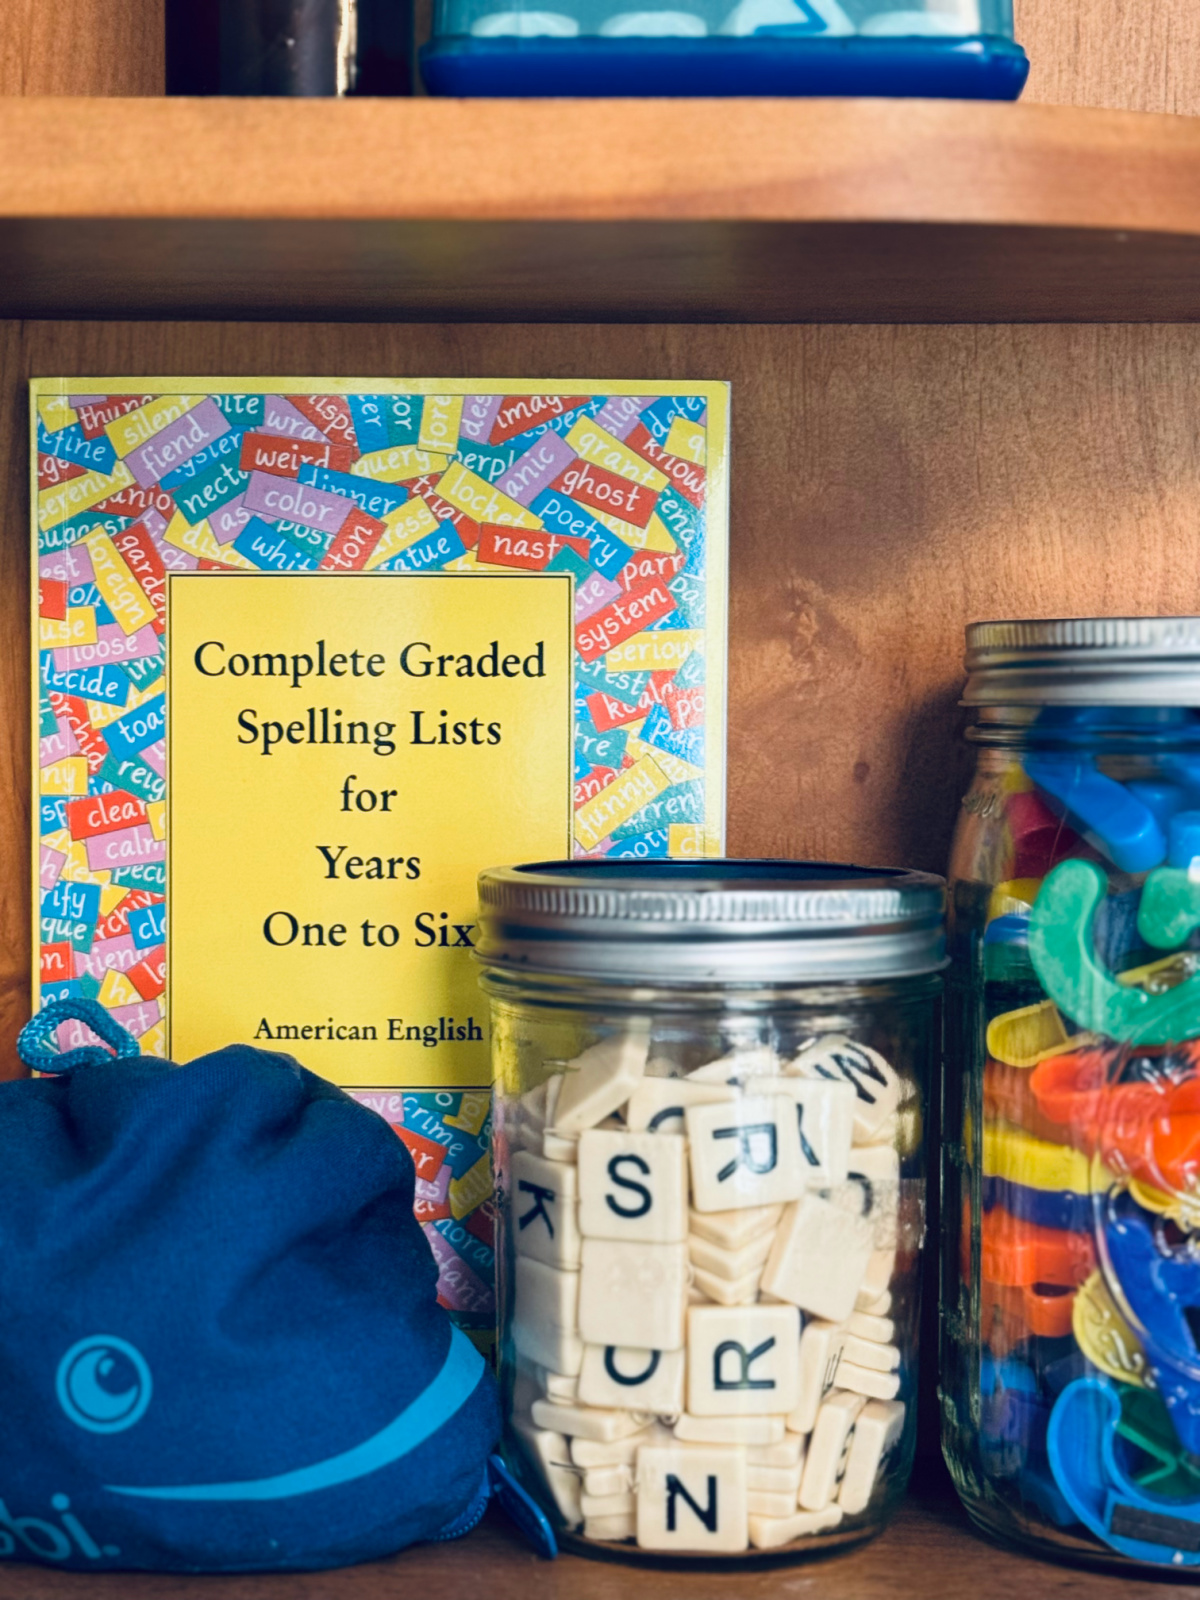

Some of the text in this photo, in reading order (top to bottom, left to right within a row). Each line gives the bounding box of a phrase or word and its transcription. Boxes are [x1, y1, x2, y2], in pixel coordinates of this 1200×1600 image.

[267, 411, 327, 441] wra
[497, 396, 571, 428] imag
[651, 397, 706, 438] defe
[38, 416, 106, 461] efine
[142, 414, 210, 482] fiend
[255, 444, 331, 470] weird
[576, 433, 655, 486] grant
[265, 486, 333, 521] color
[450, 470, 525, 526] locket
[562, 464, 640, 511] ghost
[538, 499, 617, 567] poetry
[576, 581, 605, 613] te
[578, 588, 667, 650] system
[73, 634, 138, 662] loose
[194, 640, 546, 688] Complete Graded
[117, 705, 165, 743] toa
[238, 707, 501, 756] Spelling Lists
[341, 775, 398, 812] for
[575, 773, 660, 840] funny
[316, 845, 421, 880] Years
[263, 911, 475, 948] One to Six
[253, 1018, 483, 1047] American English
[403, 1097, 464, 1157] crime
[713, 1122, 778, 1182] R
[518, 1180, 555, 1238] K
[605, 1154, 652, 1218] S
[713, 1337, 775, 1390] R
[666, 1474, 717, 1533] N
